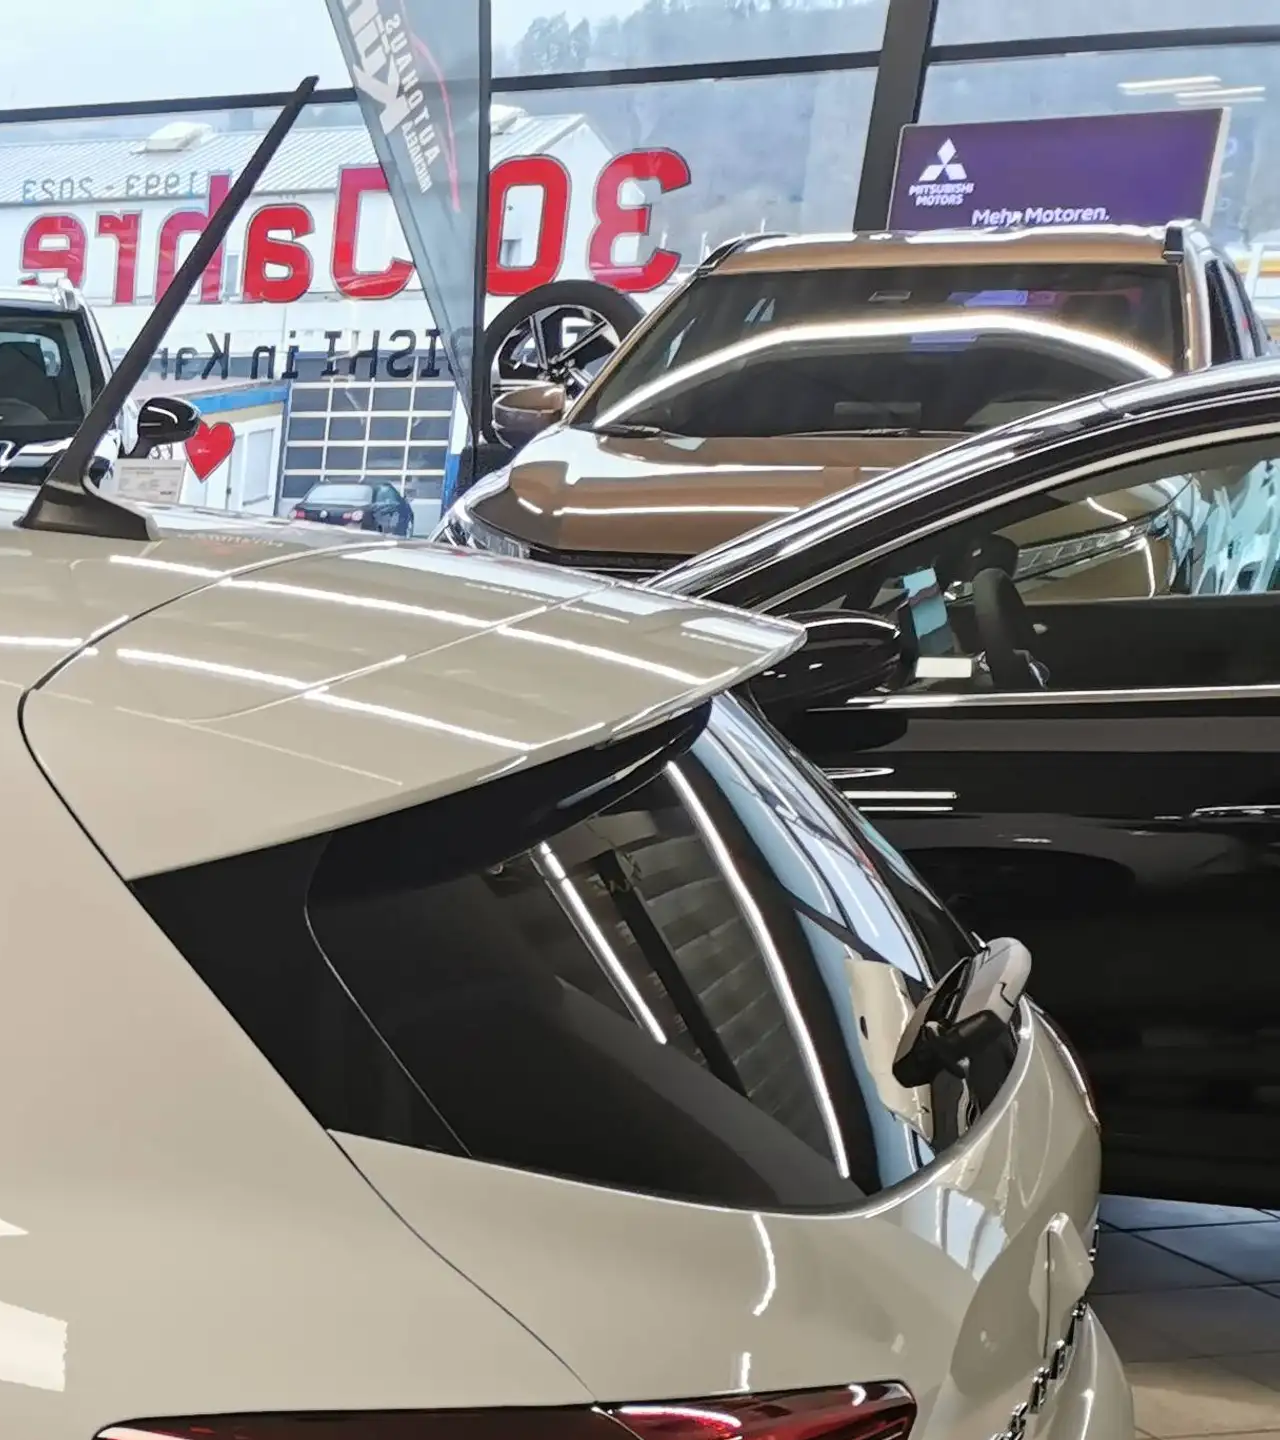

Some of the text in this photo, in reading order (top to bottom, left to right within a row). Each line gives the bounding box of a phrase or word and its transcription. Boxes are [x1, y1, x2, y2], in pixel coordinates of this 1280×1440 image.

[908, 182, 975, 196] MITSUBISHI
[915, 193, 964, 206] MOTORS
[971, 206, 1111, 227] Mehr Motoren.
